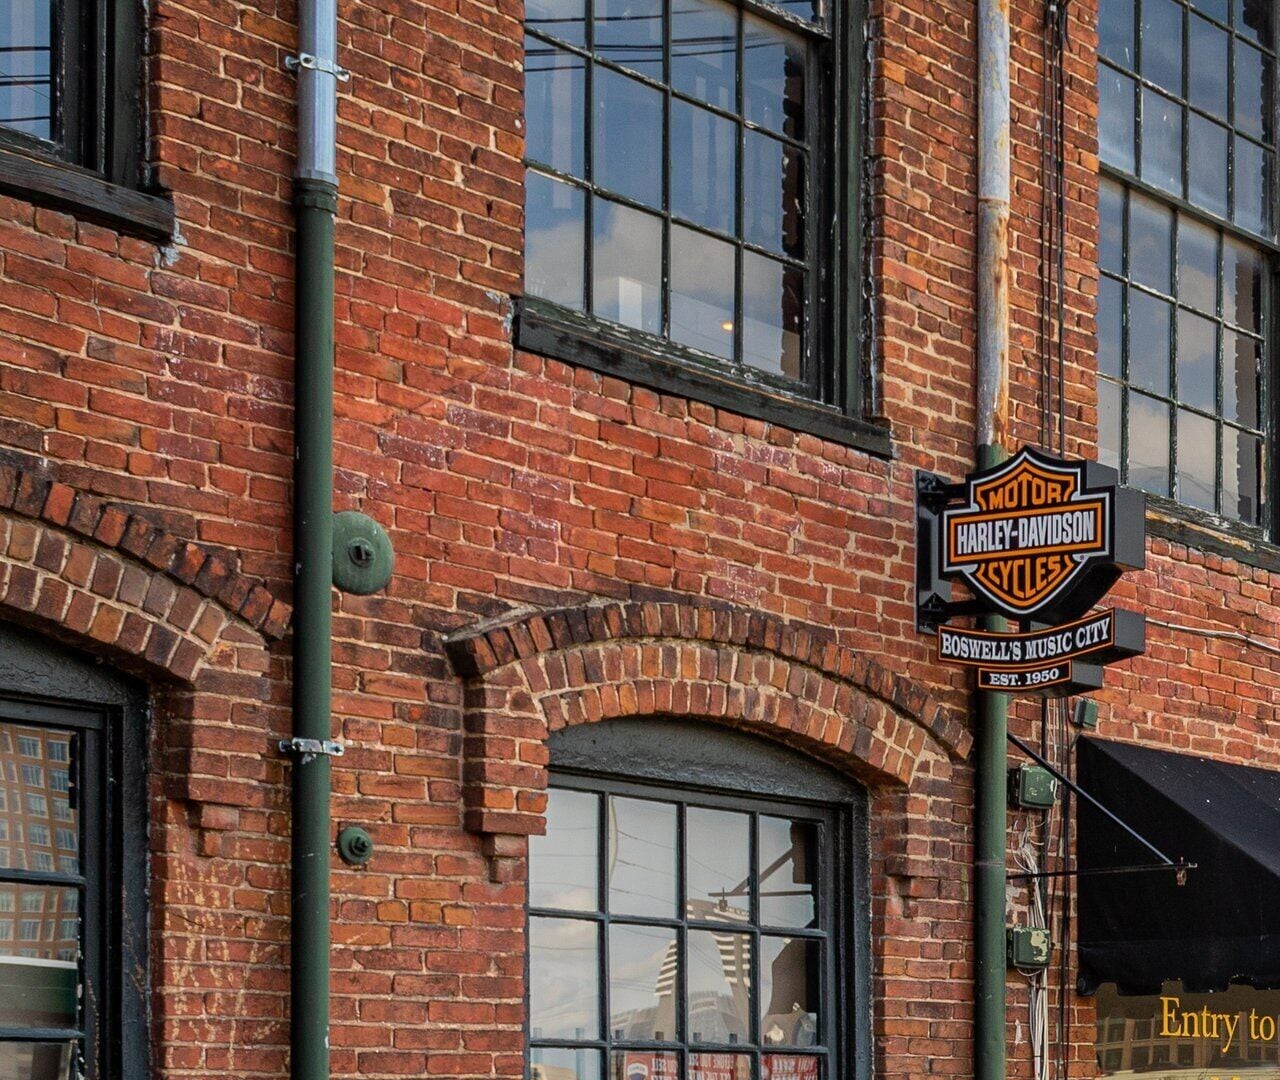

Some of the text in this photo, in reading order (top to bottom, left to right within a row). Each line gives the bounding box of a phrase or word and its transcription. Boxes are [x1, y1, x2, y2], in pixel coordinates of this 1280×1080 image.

[989, 472, 1062, 510] MOTOR
[957, 510, 1095, 554] HARLEY-DAVIDSON
[988, 554, 1061, 599] CYCLES
[941, 616, 1110, 661] BOSWELL'S MUSIC CITY
[989, 668, 1060, 686] EST. 1950
[1159, 996, 1240, 1053] Entry
[1250, 1008, 1275, 1041] to
